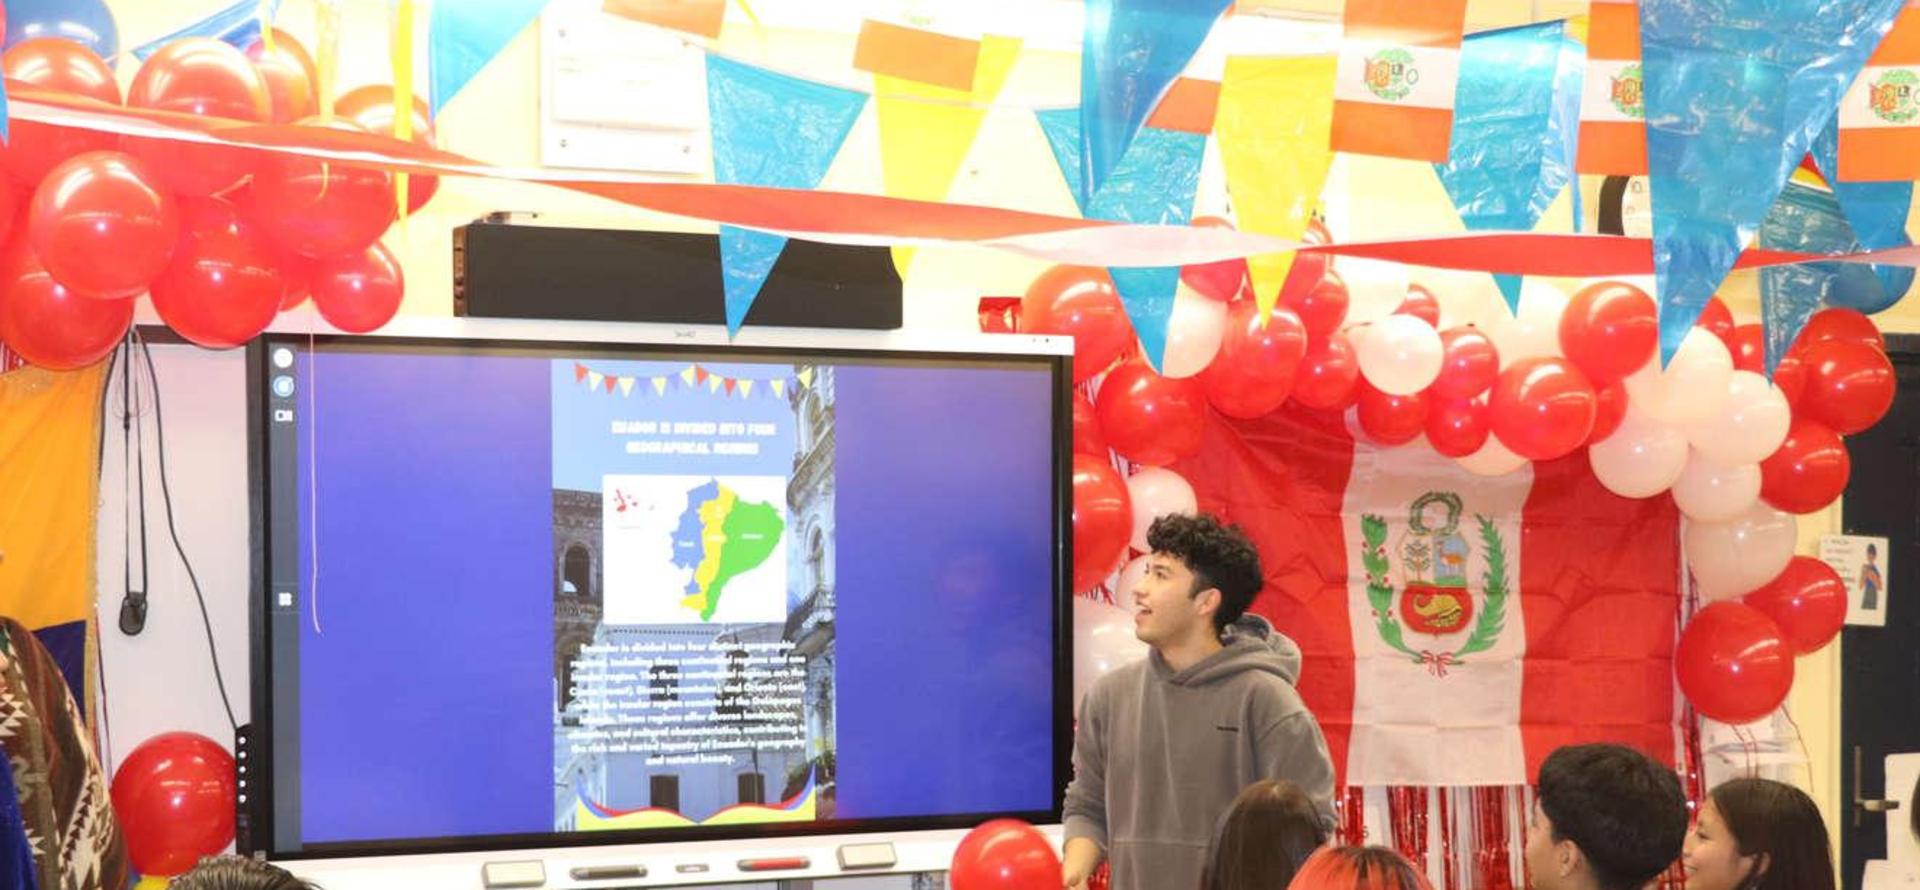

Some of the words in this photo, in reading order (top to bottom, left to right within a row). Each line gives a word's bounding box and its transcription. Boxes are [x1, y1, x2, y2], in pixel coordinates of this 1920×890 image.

[632, 642, 666, 652] divided
[770, 654, 787, 664] and
[640, 671, 657, 680] The
[659, 670, 683, 680] three
[791, 667, 805, 677] the
[724, 682, 742, 692] and
[736, 697, 750, 706] the
